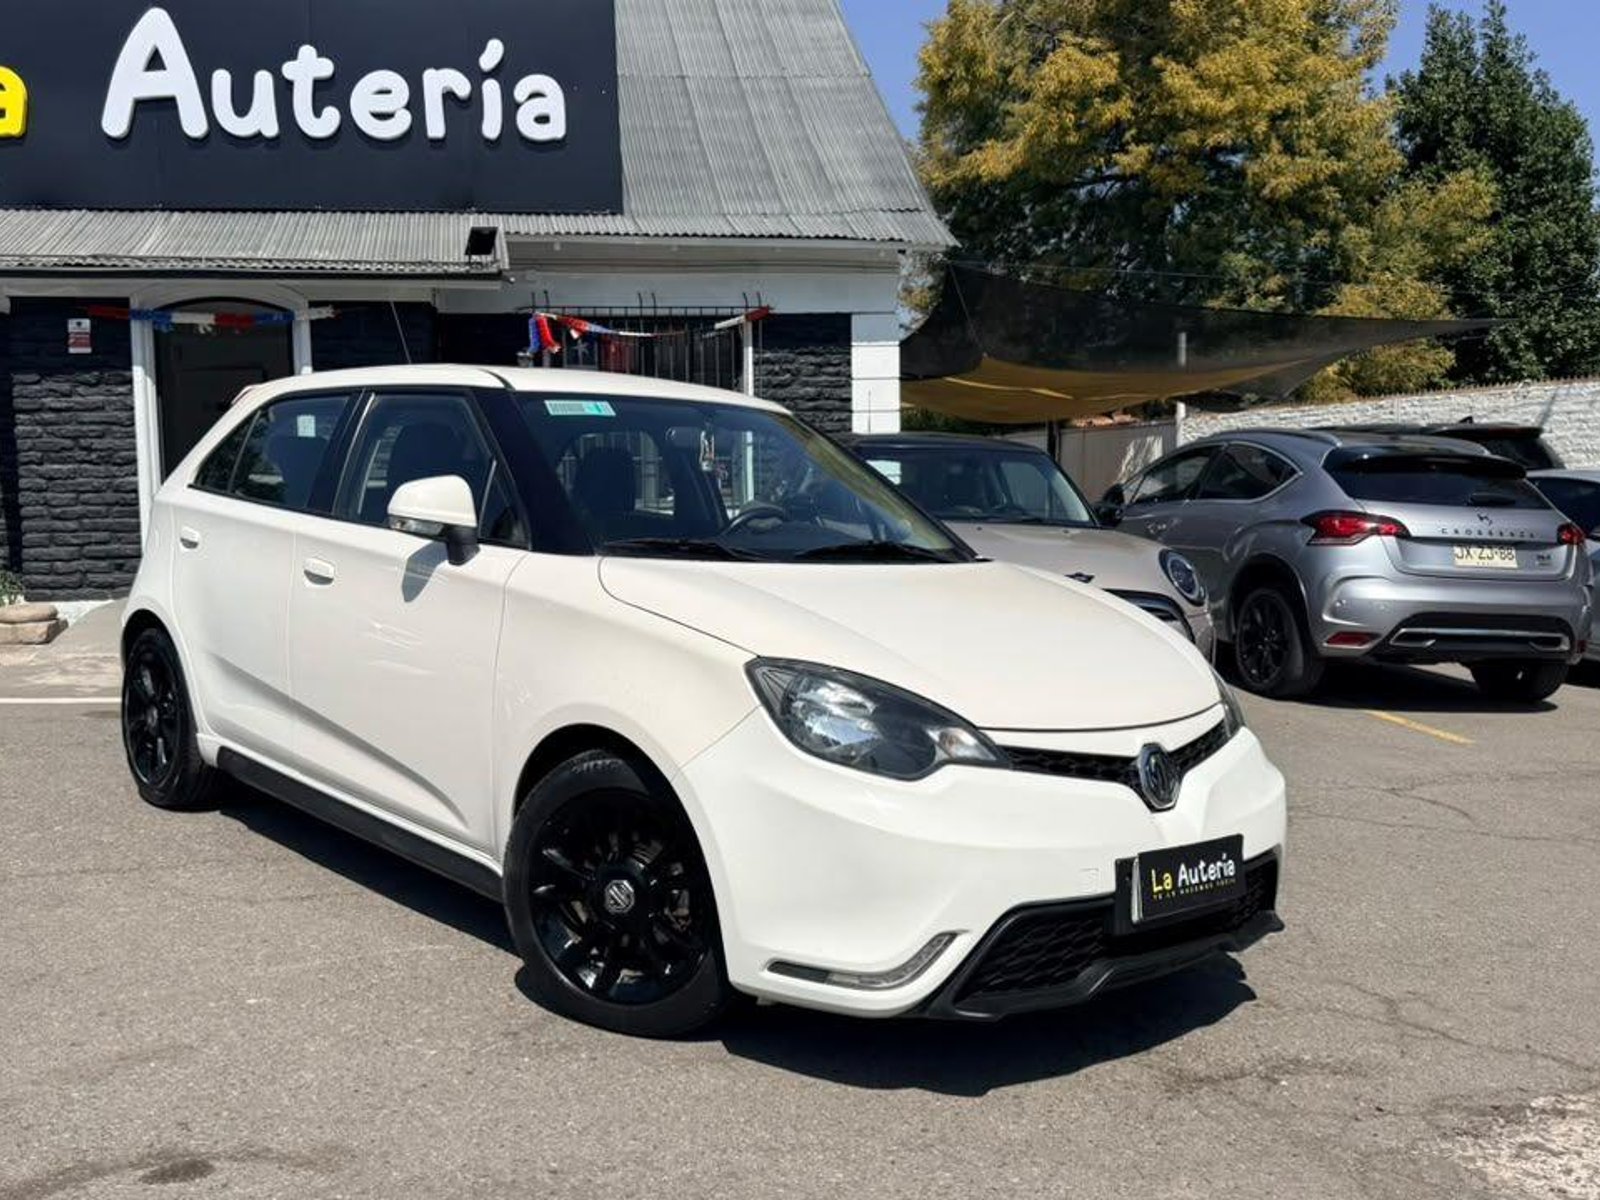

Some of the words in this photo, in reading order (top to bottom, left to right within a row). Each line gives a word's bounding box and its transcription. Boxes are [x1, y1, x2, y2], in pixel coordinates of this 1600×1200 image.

[101, 7, 567, 141] Autería
[1151, 868, 1173, 892] La
[1178, 853, 1236, 888] Autería
